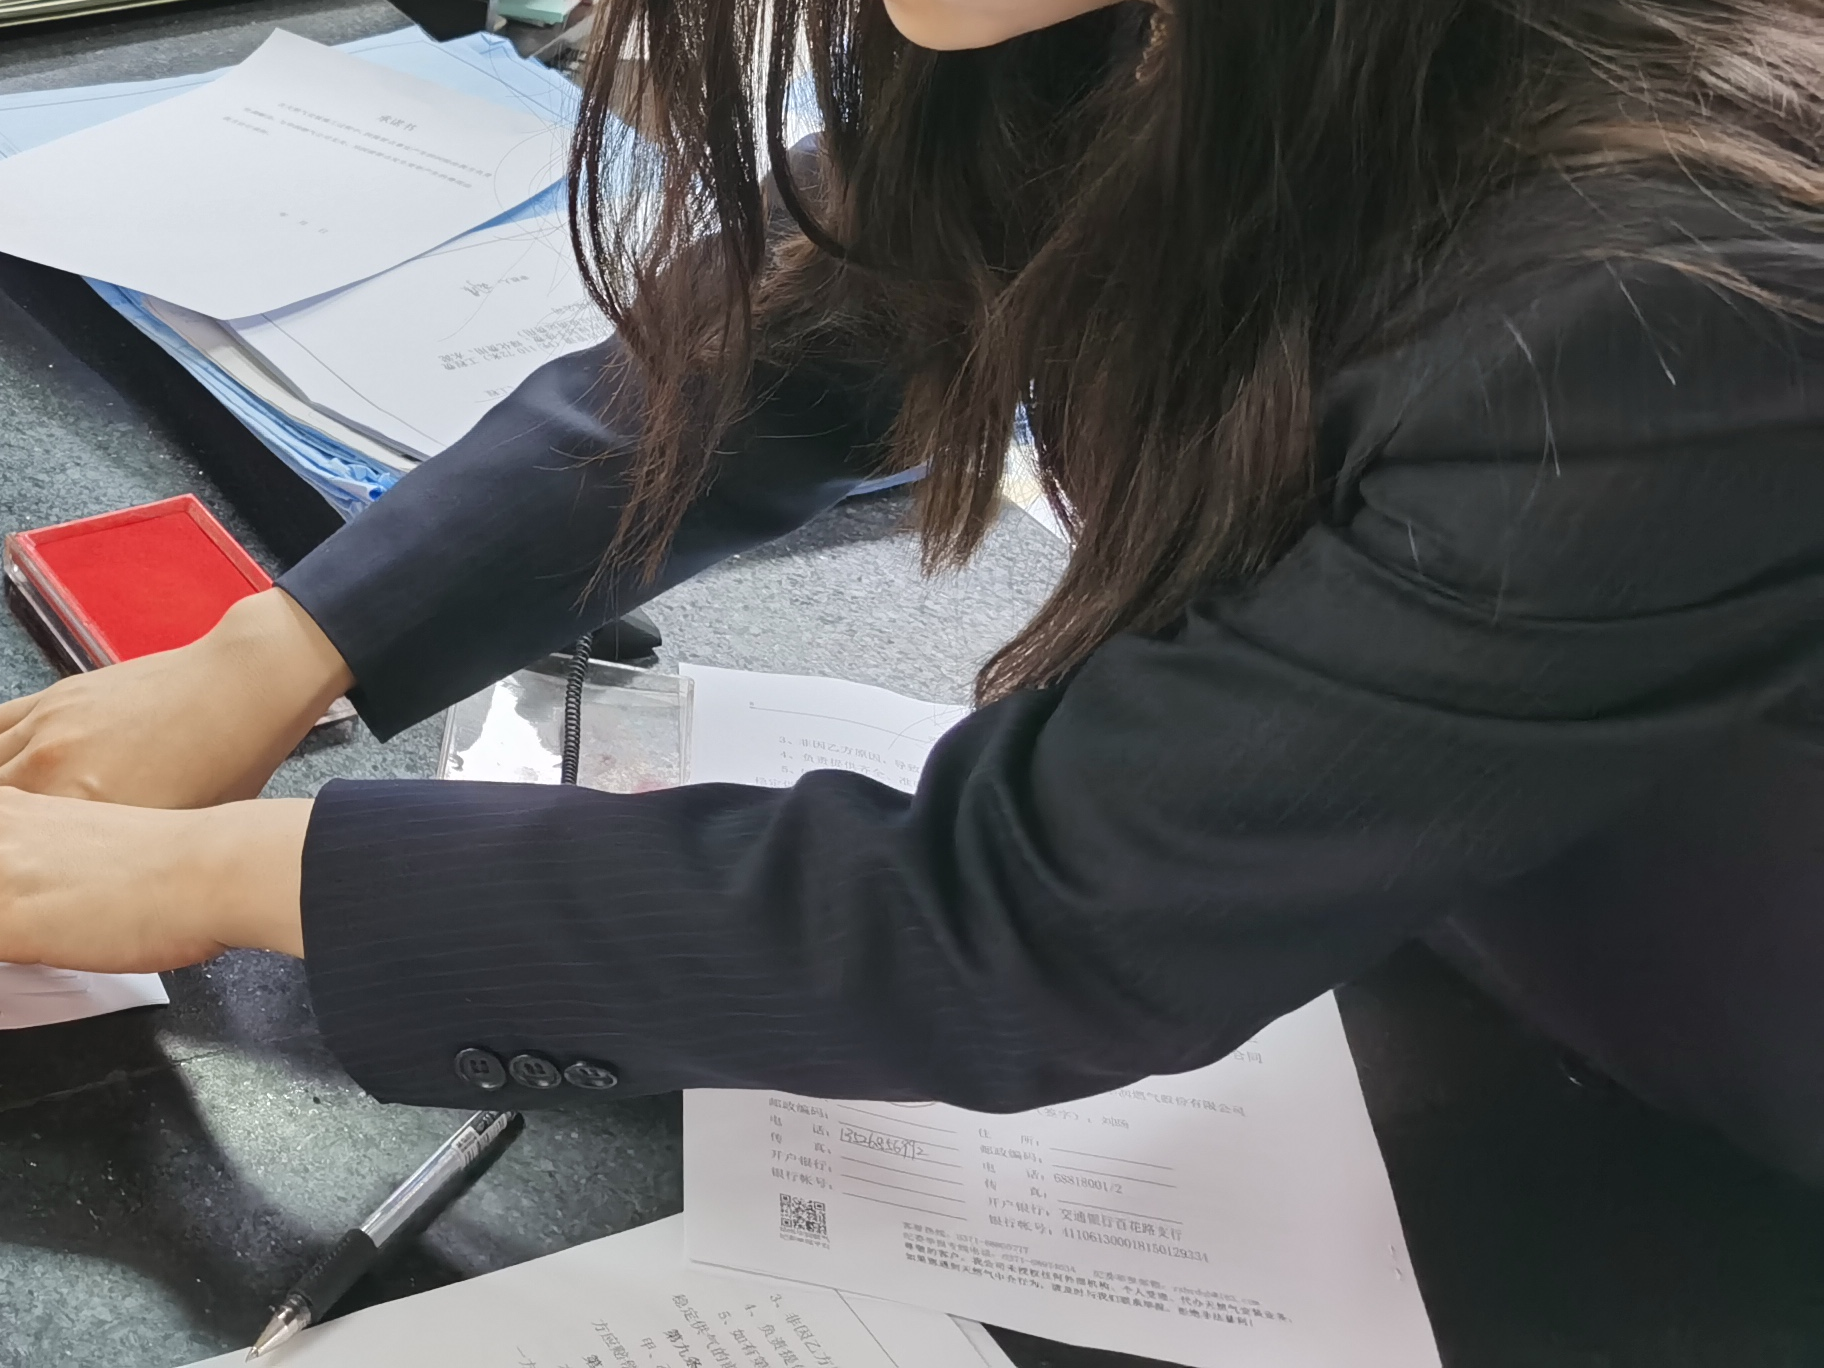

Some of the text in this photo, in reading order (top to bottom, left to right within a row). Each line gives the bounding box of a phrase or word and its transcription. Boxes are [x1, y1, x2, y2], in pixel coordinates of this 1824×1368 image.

[1110, 1088, 1246, 1117] 润燃气股份有限公司
